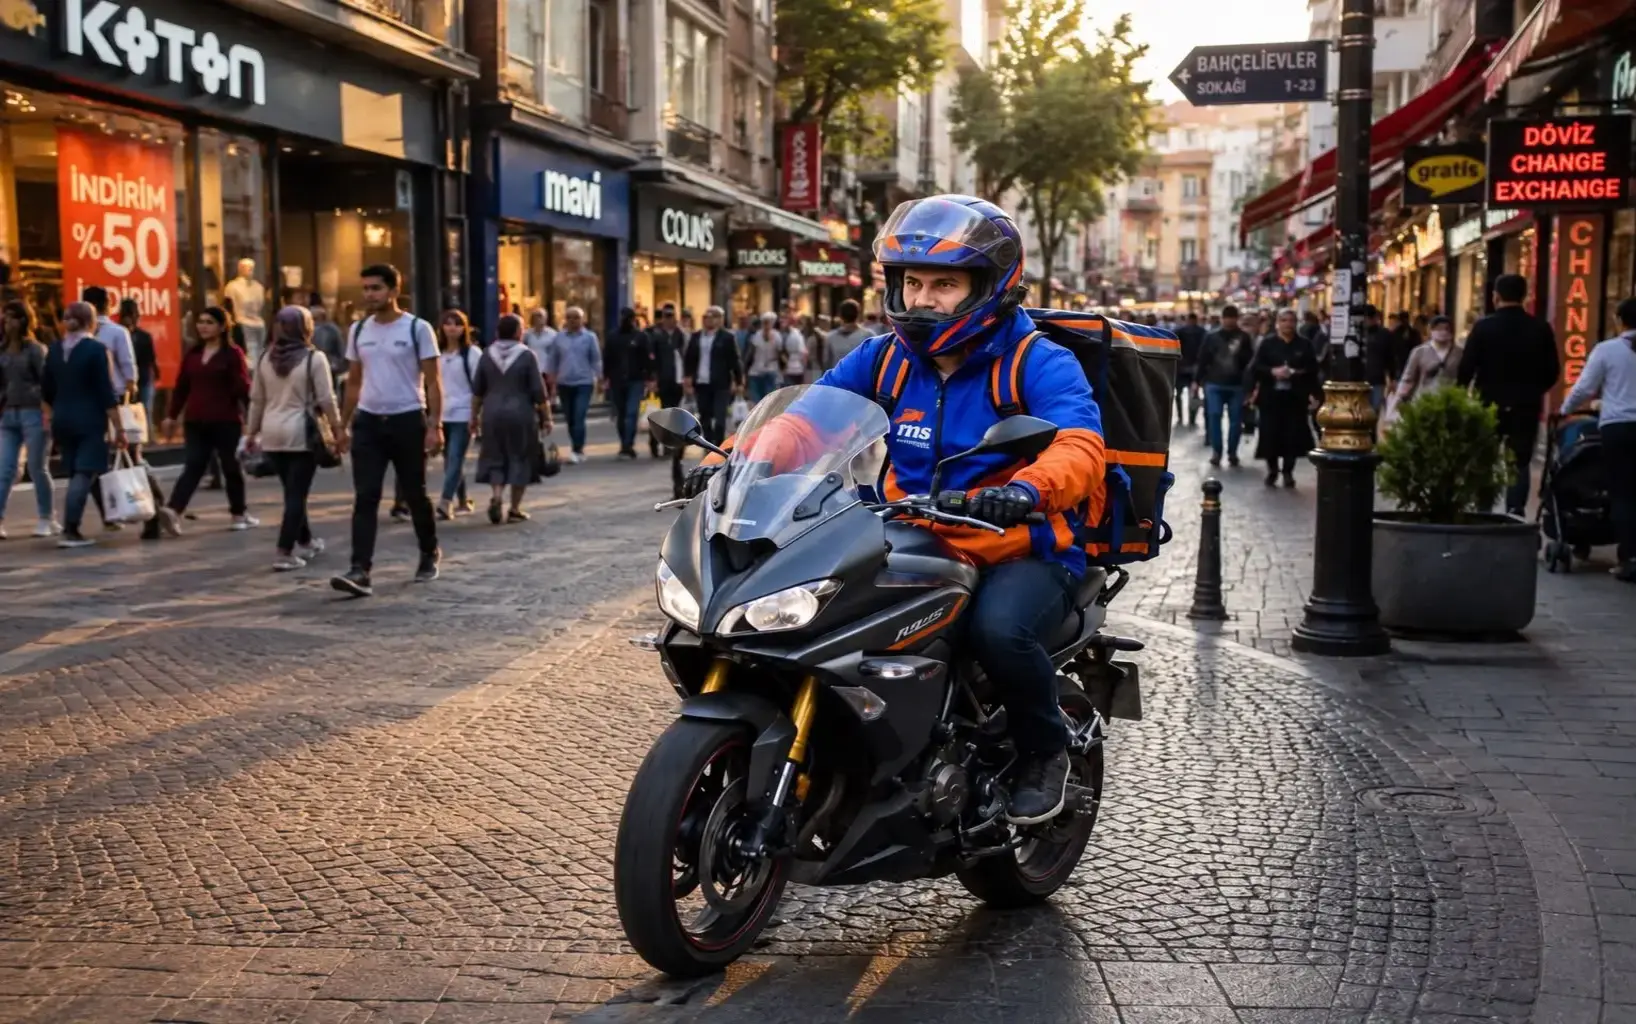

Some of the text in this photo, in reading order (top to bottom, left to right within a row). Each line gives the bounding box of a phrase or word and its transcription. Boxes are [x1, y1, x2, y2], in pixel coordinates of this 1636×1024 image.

[1197, 49, 1317, 74] BAHÇELİEVLER
[1196, 78, 1247, 95] SOKAĞI
[1524, 122, 1595, 147] DÖVİZ
[1418, 161, 1479, 182] gratis
[1511, 152, 1606, 173] CHANGE
[71, 165, 165, 212] İNDİRİM
[544, 169, 601, 220] mavi
[1496, 178, 1621, 201] EXCHANGE
[72, 212, 169, 280] %50
[76, 277, 171, 317] İDİRİM
